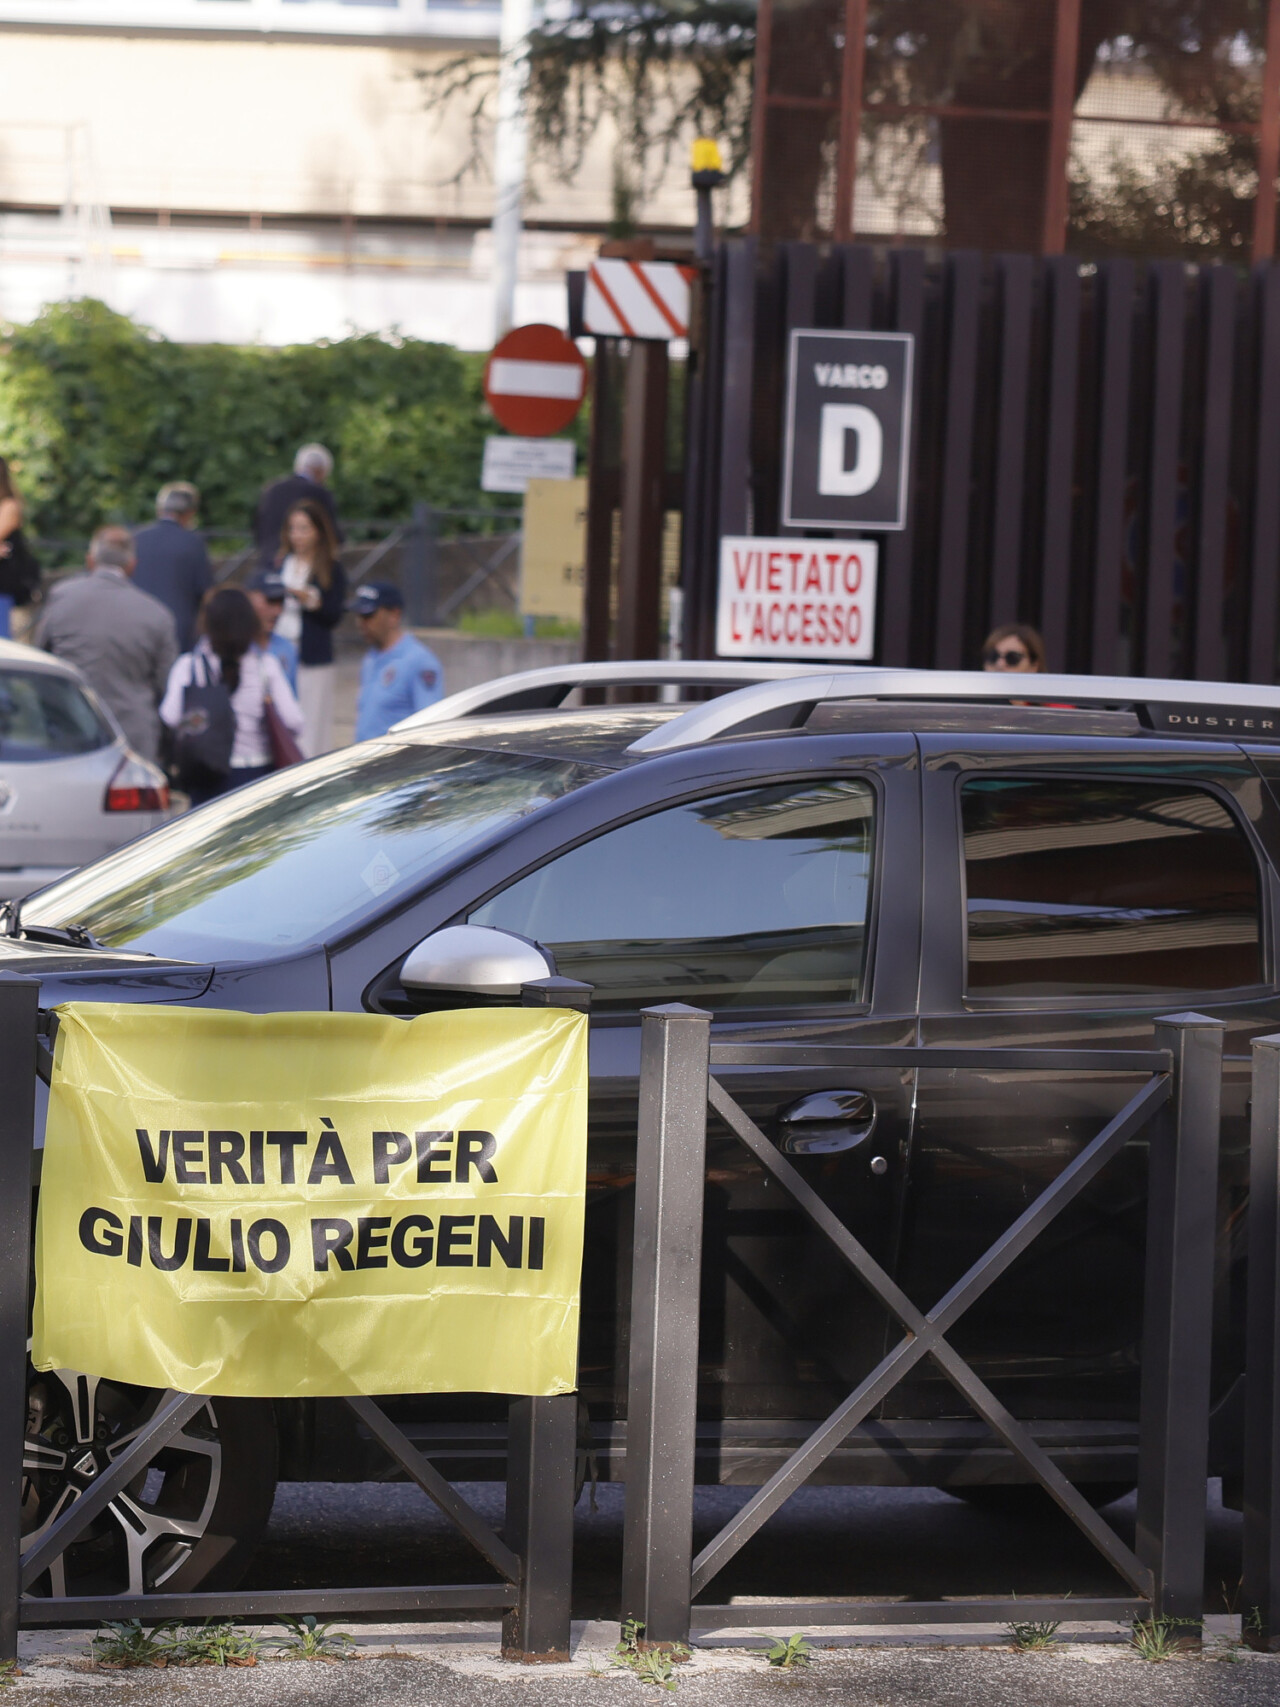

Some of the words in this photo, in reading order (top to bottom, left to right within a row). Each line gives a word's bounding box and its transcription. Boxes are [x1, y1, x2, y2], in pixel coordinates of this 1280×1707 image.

[814, 363, 889, 390] VARCO
[818, 402, 883, 497] D
[733, 551, 863, 595] VIETATO
[731, 602, 862, 646] L'ACCESSO
[1168, 714, 1274, 730] DUSTER
[135, 1117, 354, 1185] VERITÀ
[371, 1129, 499, 1184] PER
[78, 1207, 291, 1274] GIULIO
[310, 1214, 545, 1272] REGENI
